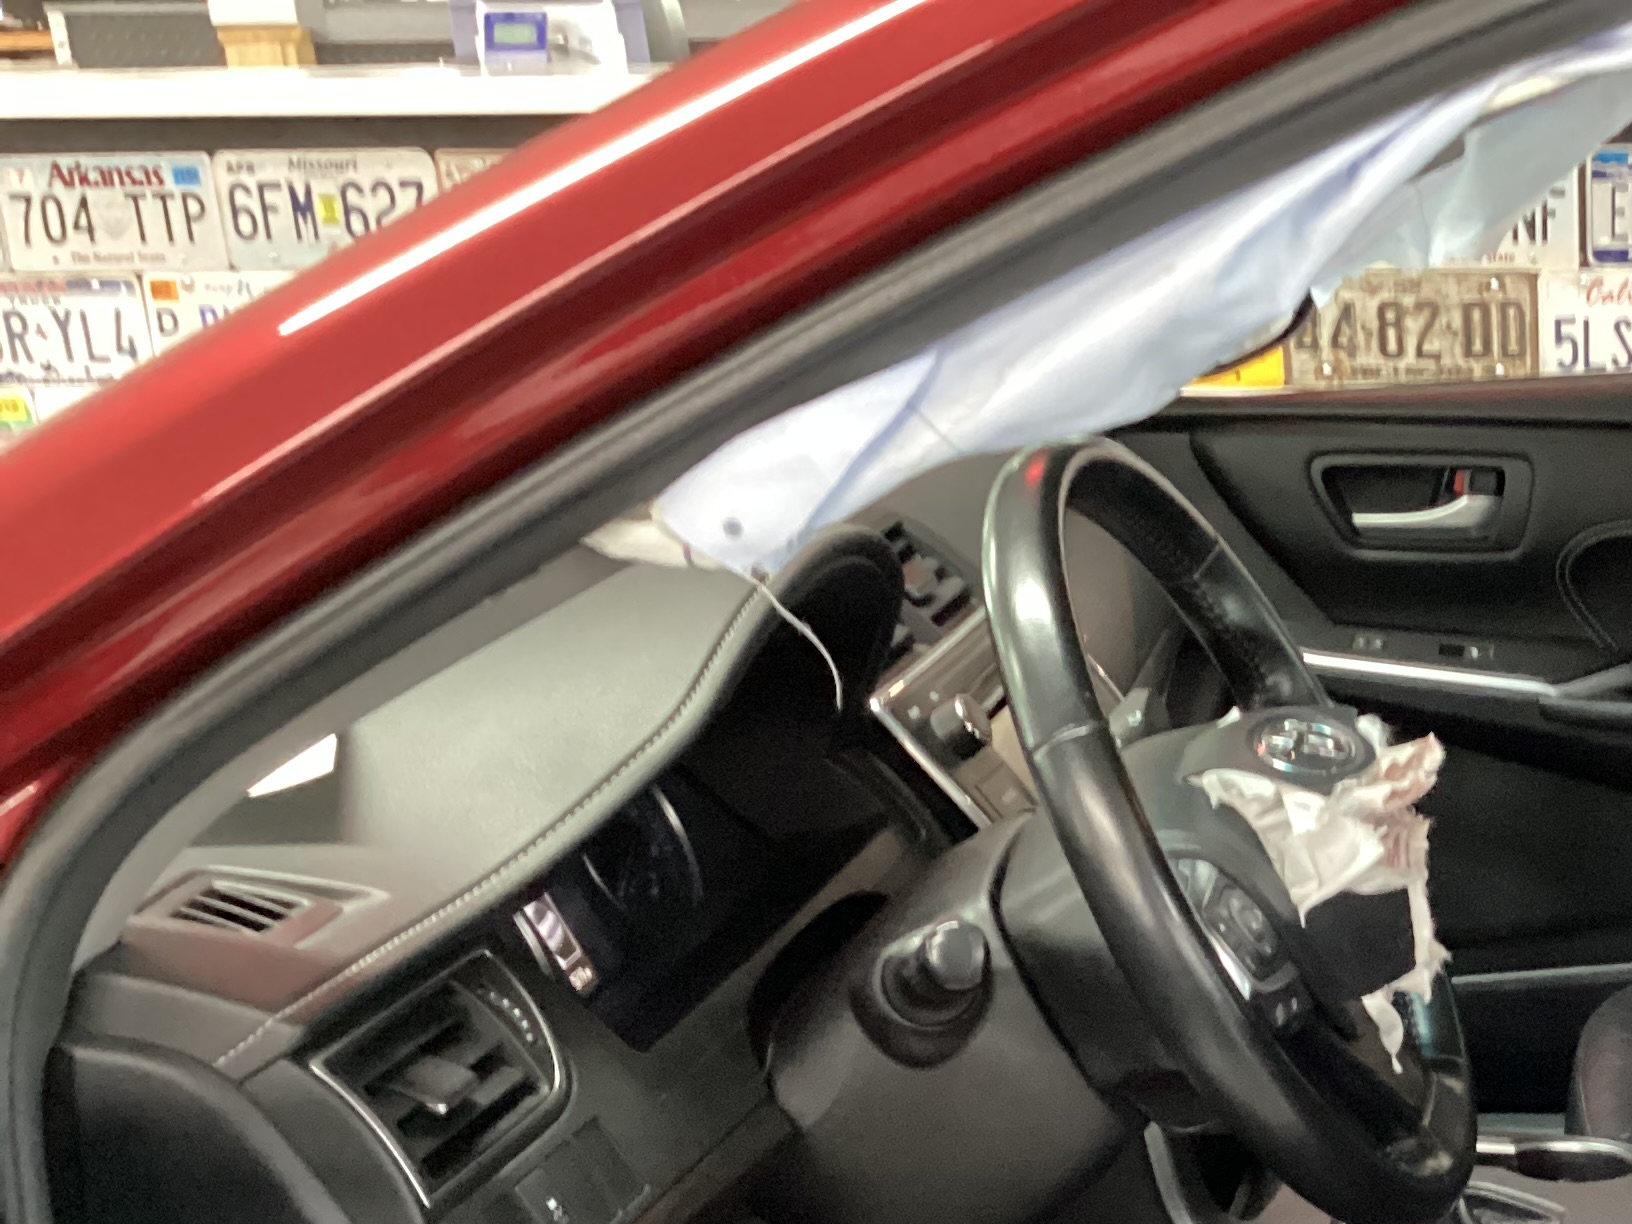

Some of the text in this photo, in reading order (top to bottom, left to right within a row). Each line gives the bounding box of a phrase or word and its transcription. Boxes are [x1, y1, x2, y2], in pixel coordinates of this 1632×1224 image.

[49, 160, 166, 188] Arkansas
[287, 157, 359, 174] Missouri
[8, 190, 206, 246] 704 TTP
[228, 179, 321, 244] 6FM
